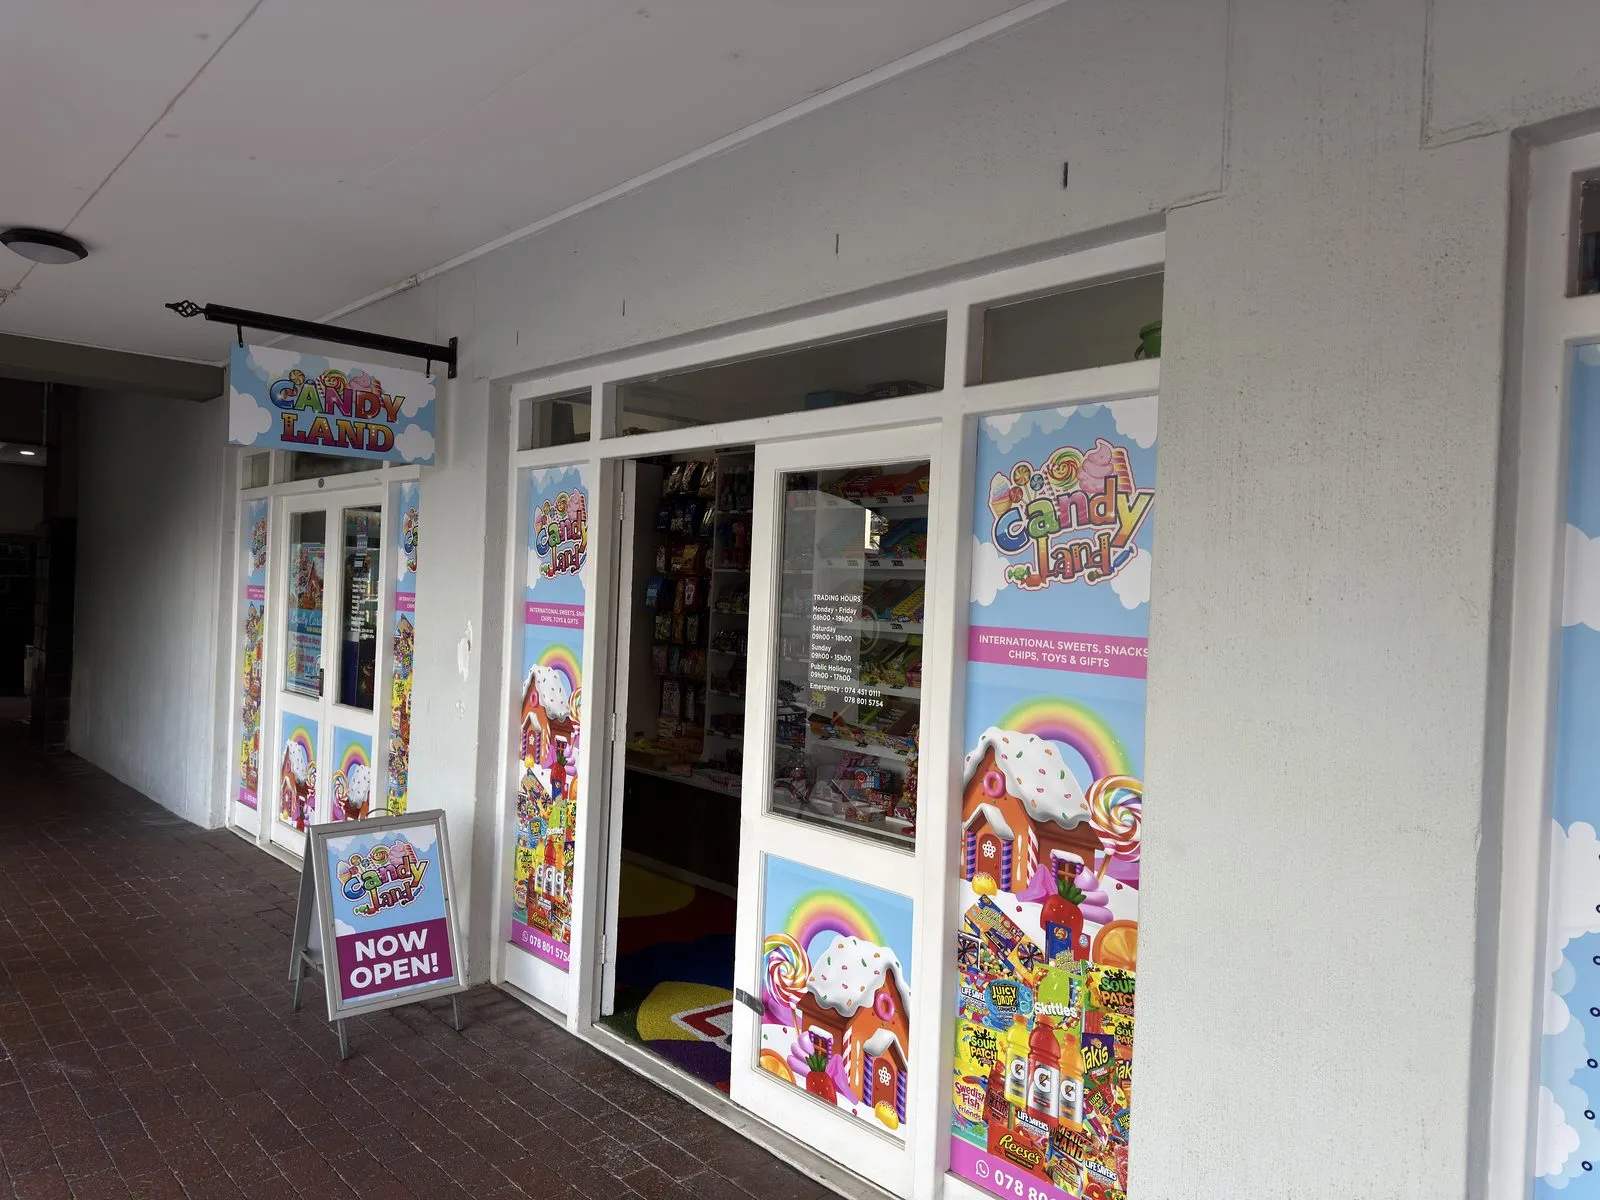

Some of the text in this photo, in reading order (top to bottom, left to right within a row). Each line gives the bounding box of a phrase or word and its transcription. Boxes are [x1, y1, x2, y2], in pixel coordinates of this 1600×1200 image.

[270, 378, 406, 423] CANDY
[281, 412, 395, 452] LAND
[813, 594, 862, 603] TRADING HOURS
[812, 605, 834, 614] Monday
[839, 606, 857, 616] Friday
[812, 614, 831, 622] 08h00
[836, 615, 853, 623] 19h00
[812, 625, 837, 634] Saturday
[812, 633, 831, 641] 09h00
[835, 634, 853, 642] 18h00
[811, 643, 832, 652] Sunday
[979, 634, 1149, 659] INTERNATIONAL SWEETS, SNACKS
[811, 652, 830, 660] 09h00
[834, 653, 852, 662] 15h00
[1008, 650, 1110, 669] CHIPS, TOYS & GIFTS
[810, 662, 827, 671] Public
[828, 664, 853, 674] Holidays
[810, 671, 829, 679] 09h00
[833, 673, 851, 682] 17h00
[810, 682, 841, 693] Emergency
[844, 687, 856, 695] 074
[857, 688, 868, 696] 451
[844, 695, 884, 708] 078 801 5754
[355, 928, 428, 962] NOW
[529, 934, 541, 949] 078
[542, 940, 554, 956] 801
[350, 952, 439, 989] OPEN!
[992, 985, 1016, 999] JUICY
[1101, 991, 1134, 1007] PATC
[997, 994, 1014, 1006] DROP
[1034, 1001, 1078, 1018] Skittles
[970, 1036, 996, 1050] SOUR
[970, 1046, 998, 1060] PATCH
[1081, 1046, 1109, 1074] Takis
[1033, 1067, 1051, 1093] G
[1061, 1080, 1078, 1102] G
[1089, 1091, 1103, 1105] JUICY
[962, 1094, 980, 1110] Fish
[999, 1134, 1042, 1165] Reese's
[1085, 1160, 1097, 1171] LIFE
[1098, 1164, 1117, 1180] SAVERS
[994, 1169, 1024, 1197] 078
